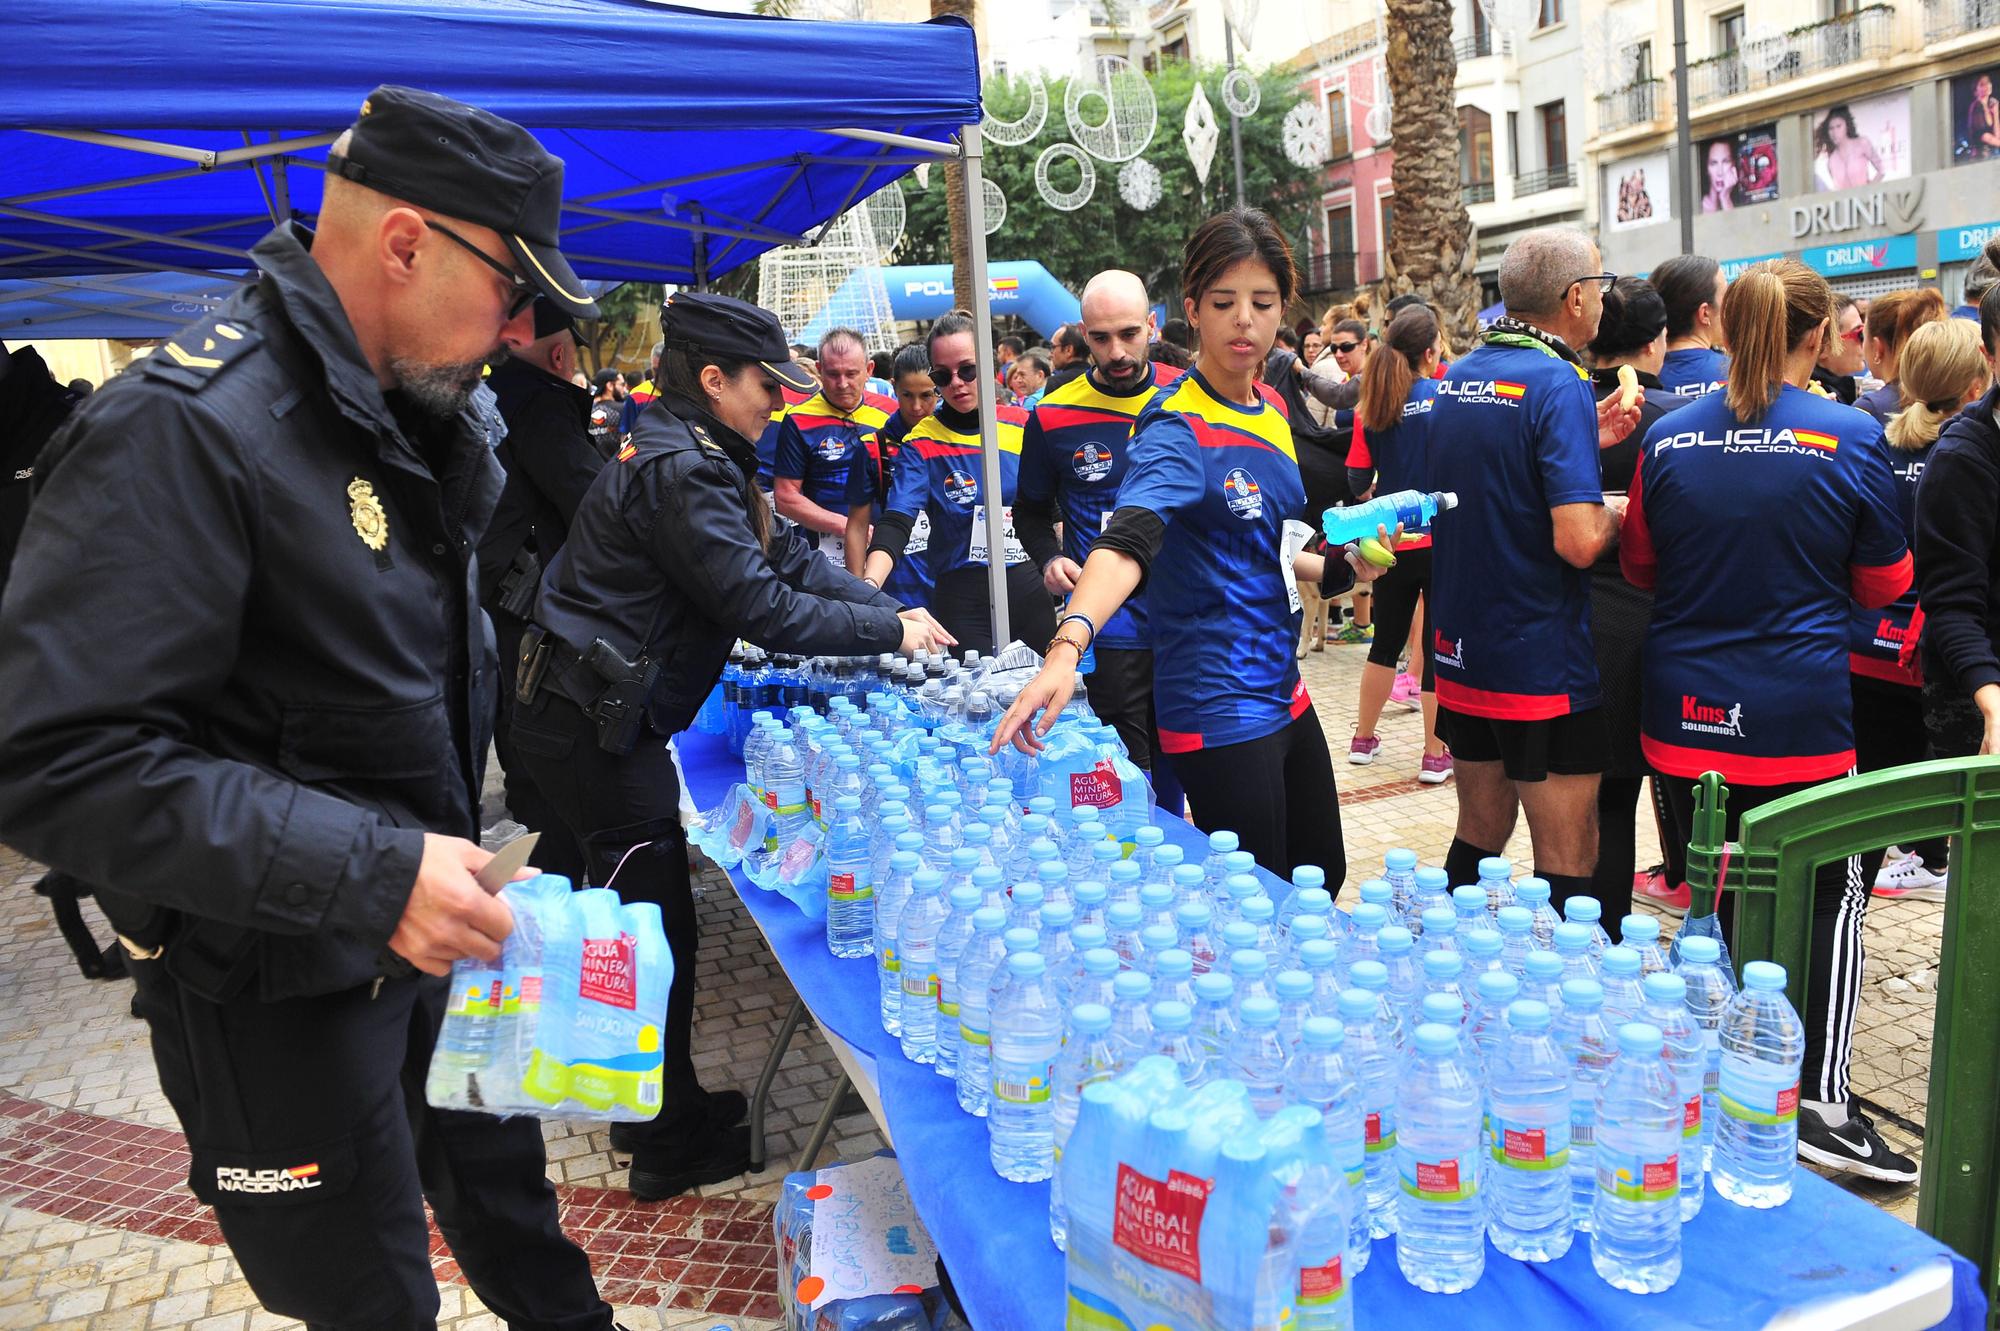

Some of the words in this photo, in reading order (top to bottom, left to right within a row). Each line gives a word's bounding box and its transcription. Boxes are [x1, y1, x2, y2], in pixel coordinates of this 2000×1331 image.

[1791, 192, 1886, 237] DRUNI
[1826, 244, 1875, 266] DRUNI
[1457, 396, 1519, 407] NACIONAL
[1723, 445, 1834, 461] NACIONAL
[1682, 695, 1725, 723] Kms
[1681, 721, 1736, 736] SOLIDARIOS
[1074, 789, 1113, 803] NATURAL
[217, 1177, 321, 1193] NACIONAL
[1121, 1174, 1156, 1208] AGUA
[1120, 1191, 1191, 1235] MINERAL
[1119, 1210, 1191, 1255] NATURAL
